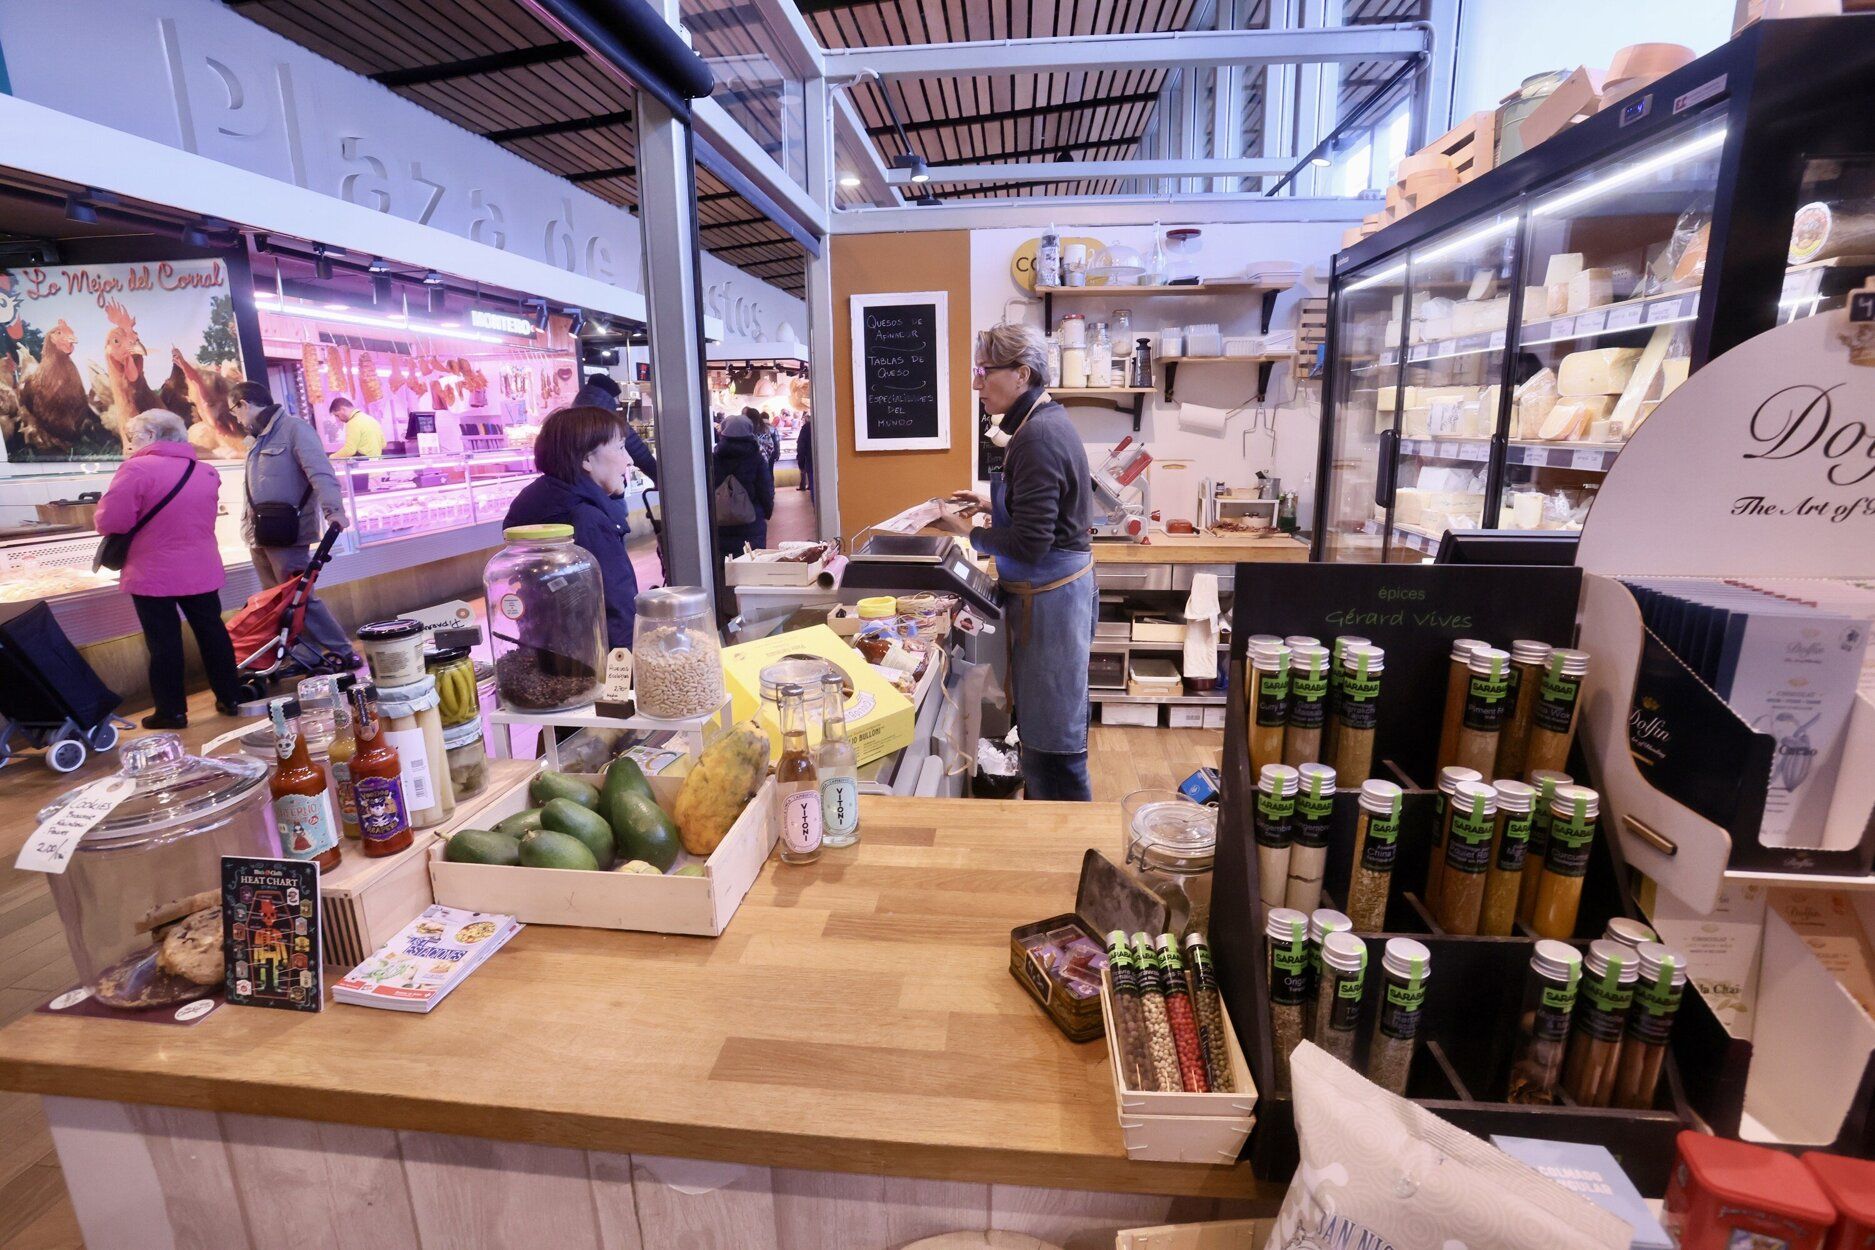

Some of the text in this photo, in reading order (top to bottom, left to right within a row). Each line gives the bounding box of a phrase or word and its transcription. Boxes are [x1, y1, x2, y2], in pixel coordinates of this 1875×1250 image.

[22, 260, 225, 308] Lo Mejor del Corral
[471, 310, 532, 335] MONTERO
[868, 355, 925, 366] TABLAS DE
[877, 367, 910, 379] QUESO
[887, 405, 906, 414] DEL
[877, 418, 913, 428] MUNDO
[1730, 495, 1777, 516] The
[1779, 495, 1830, 516] Art
[1830, 496, 1870, 524] of
[1378, 586, 1426, 601] épices
[1325, 608, 1404, 627] Gérard
[1263, 680, 1288, 690] SARA
[1294, 682, 1327, 693] SARABA
[1628, 707, 1673, 744] Dolfin
[836, 787, 845, 826] VITONI
[800, 802, 810, 842] VITONI
[240, 875, 299, 887] HEAT CHART
[1316, 1213, 1357, 1250] SAN
